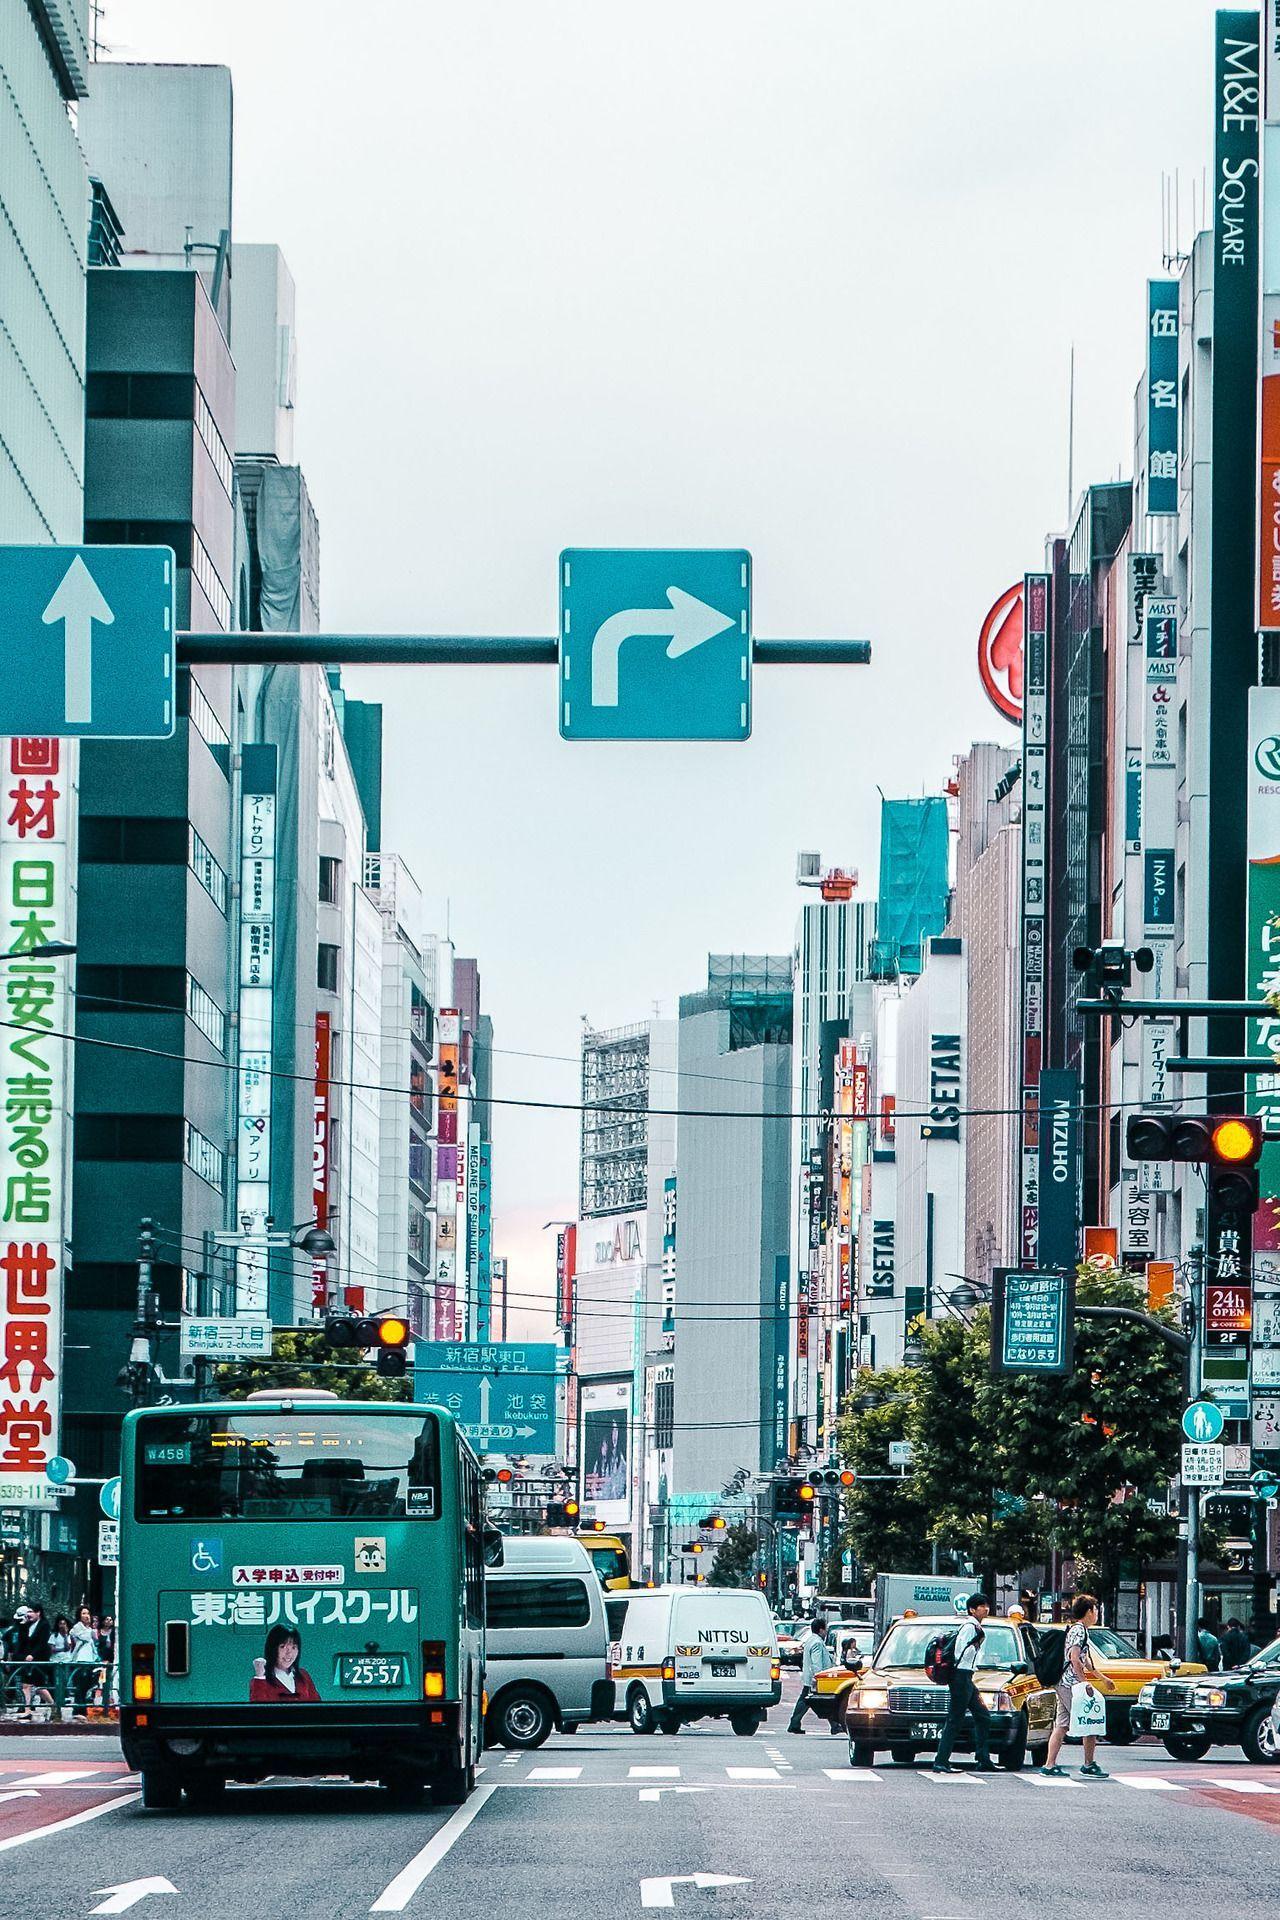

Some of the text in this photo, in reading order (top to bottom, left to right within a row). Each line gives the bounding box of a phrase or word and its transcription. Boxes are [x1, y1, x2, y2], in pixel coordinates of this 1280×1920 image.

[1219, 38, 1258, 266] M&E SQUARE
[1149, 309, 1178, 479] 伍名館
[1149, 605, 1175, 615] MAST
[1148, 663, 1175, 673] MAST
[251, 796, 263, 854] アートサロン
[1153, 861, 1166, 896] INAP
[921, 1034, 961, 1143] ISETAN
[1053, 1100, 1069, 1182] MIZUHO
[469, 1145, 478, 1188] MEGANE
[469, 1192, 478, 1211] TOP
[866, 1220, 895, 1297] ISETAN
[1212, 1290, 1245, 1308] 24h
[1212, 1308, 1246, 1317] OPEN
[189, 1325, 264, 1341] 新宿二丁目
[1220, 1332, 1238, 1343] 2F
[226, 1340, 264, 1349] 2-chome
[0, 1242, 56, 1472] 世界堂
[445, 1347, 526, 1363] 新宿駅東口
[507, 1393, 547, 1410] 池袋
[504, 1411, 549, 1420] Ikebukuro
[147, 1447, 184, 1463] W458
[235, 1567, 342, 1584] 入学申込 受付中!
[190, 1590, 418, 1626] 東進ハイスクール
[698, 1630, 749, 1644] NITTSU
[351, 1665, 400, 1684] 25-57
